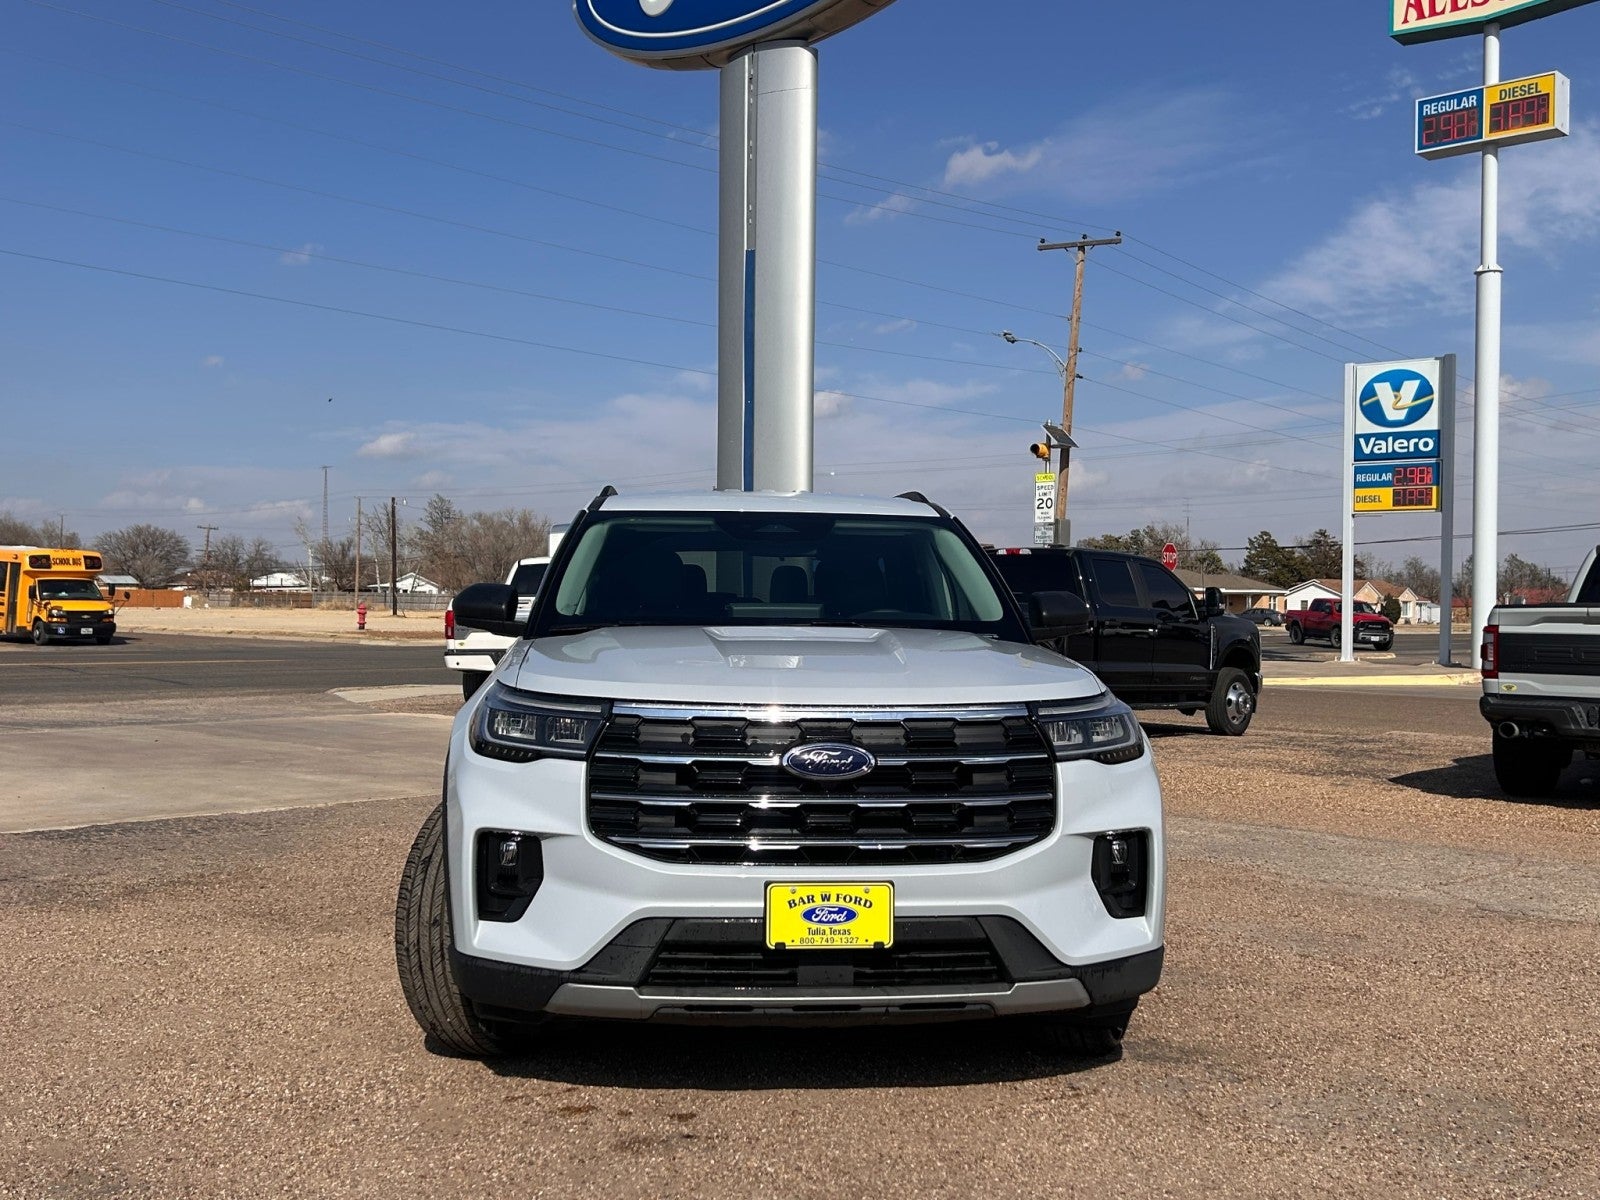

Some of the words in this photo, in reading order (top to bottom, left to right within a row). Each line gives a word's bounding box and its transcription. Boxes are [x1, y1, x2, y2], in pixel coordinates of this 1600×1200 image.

[1499, 82, 1542, 101] DIESEL
[1422, 95, 1478, 116] REGULAR
[1358, 436, 1434, 455] Valero
[1356, 472, 1392, 483] REGULAR
[1036, 498, 1053, 509] 20
[1355, 494, 1382, 504] DIESEL
[52, 557, 72, 566] SCHOOL
[72, 558, 82, 567] BUS
[1163, 552, 1177, 564] STOP
[803, 749, 854, 771] Ford
[787, 894, 816, 909] BAR
[820, 893, 831, 902] W
[835, 893, 873, 909] FORD
[811, 907, 848, 922] Ford
[829, 927, 851, 936] Texas
[799, 936, 859, 944] 800-749-1327
